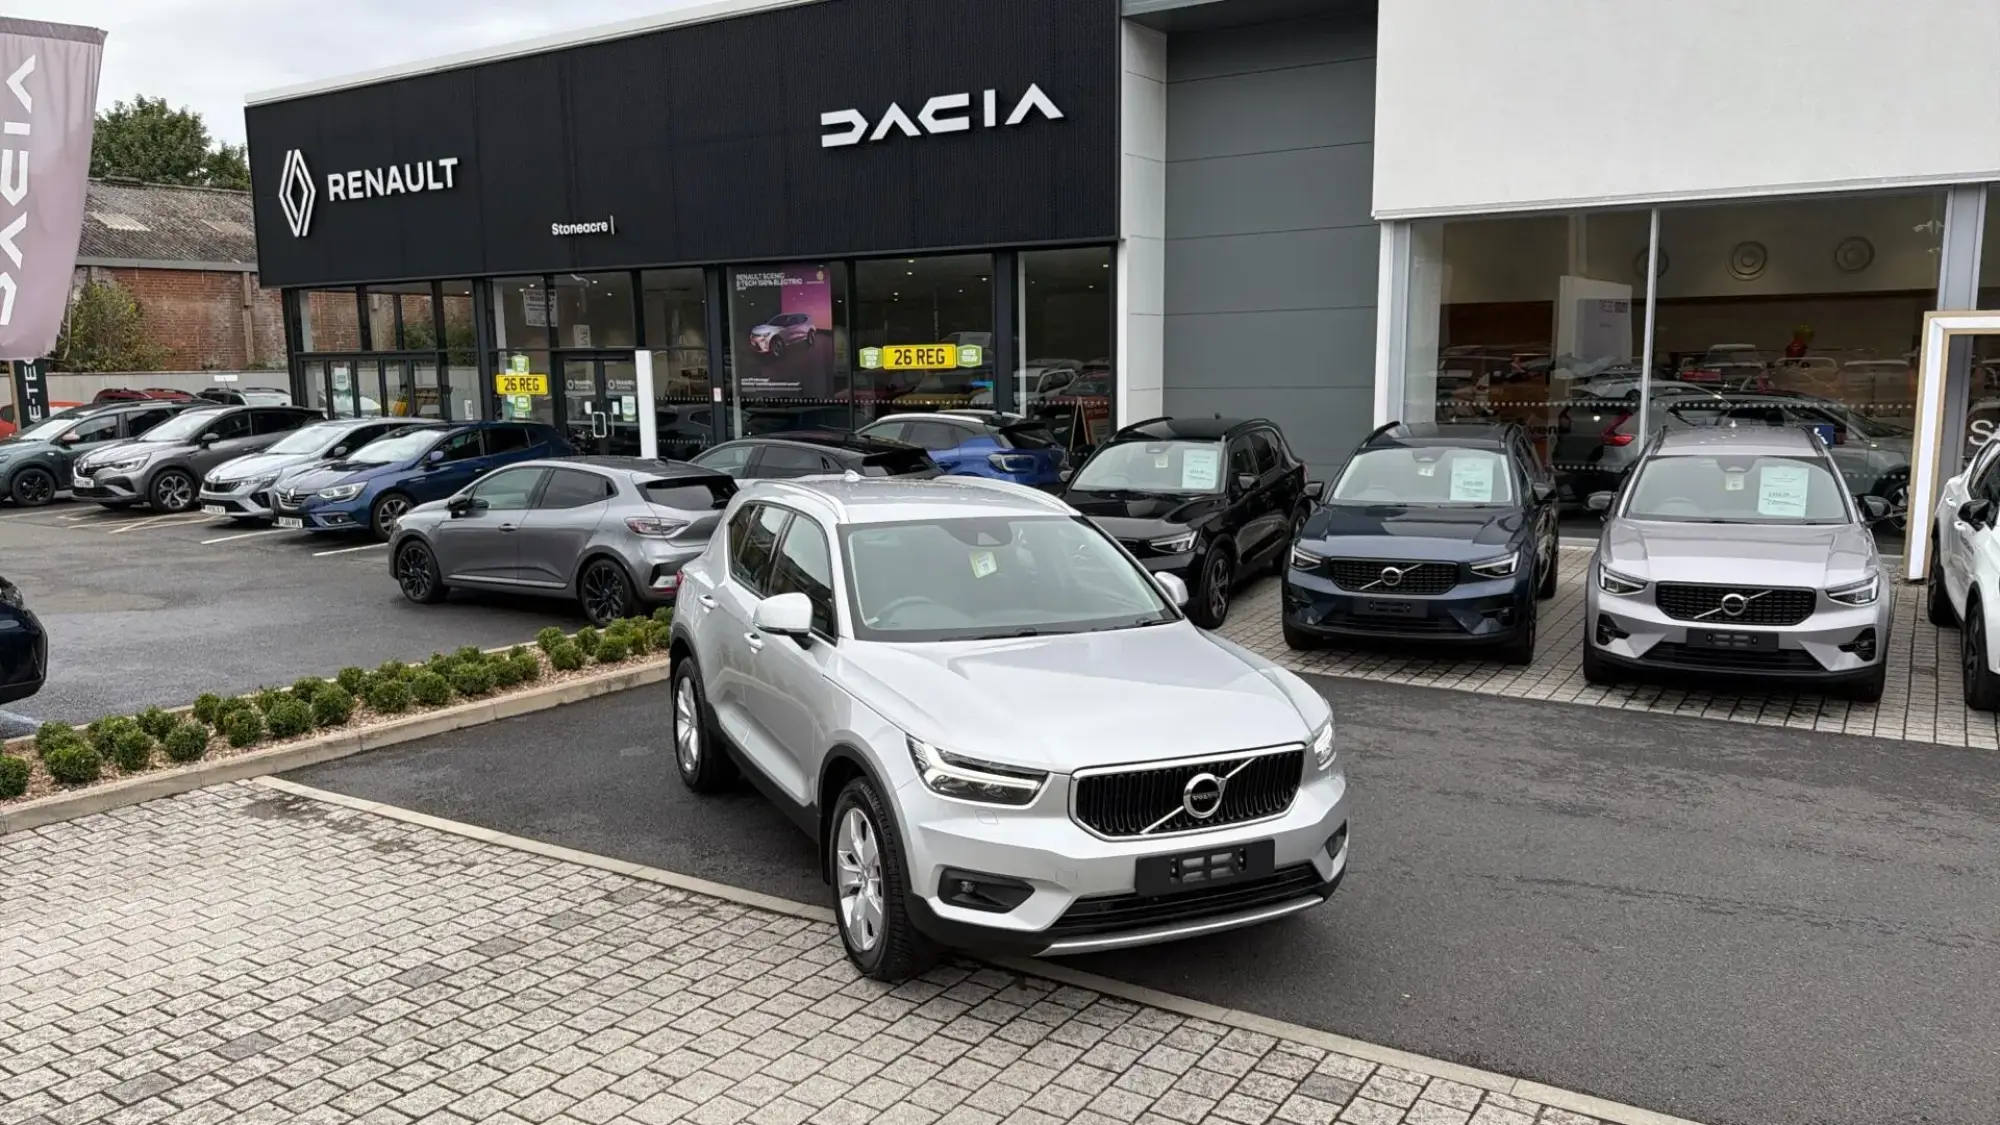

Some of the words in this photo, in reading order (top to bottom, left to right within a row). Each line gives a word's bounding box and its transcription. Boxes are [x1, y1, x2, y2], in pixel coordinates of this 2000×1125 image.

[820, 82, 1064, 148] DACIA
[327, 157, 459, 202] RENAULT
[551, 221, 608, 235] Stoneacre
[736, 273, 762, 281] RENAULT
[774, 278, 803, 286] ELECTRIC
[894, 349, 912, 365] 26
[916, 348, 945, 365] REG
[504, 378, 517, 391] 26
[519, 378, 540, 392] REG
